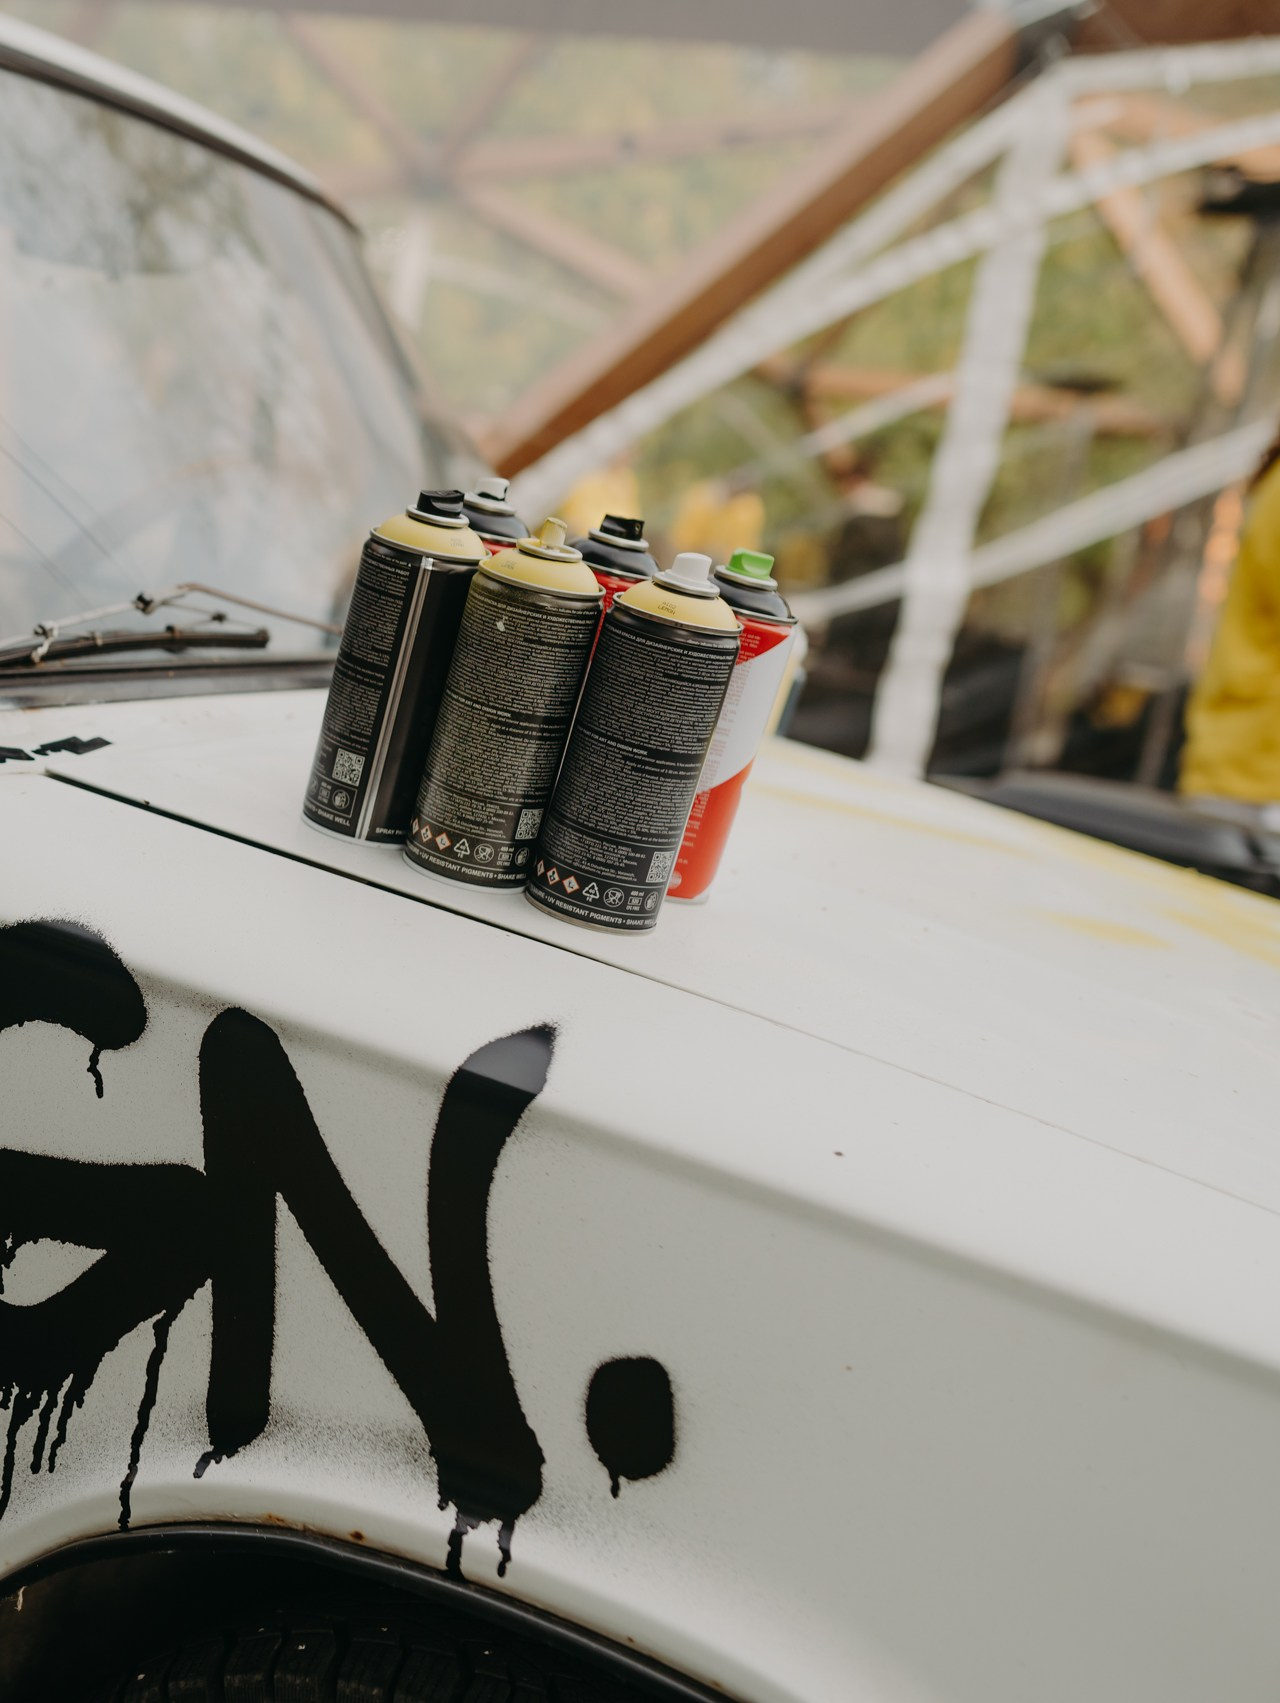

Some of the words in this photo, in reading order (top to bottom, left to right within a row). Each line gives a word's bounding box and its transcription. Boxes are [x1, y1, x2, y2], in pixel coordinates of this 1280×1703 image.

[616, 743, 632, 752] DESIGN
[334, 815, 350, 827] WELL
[428, 854, 461, 873] RESISTANT
[461, 866, 494, 879] PIGMENTS
[497, 872, 515, 880] SHAKE
[554, 899, 588, 917] RESISTANT
[589, 912, 623, 924] PIGMENTS
[626, 918, 644, 926] SHAKE
